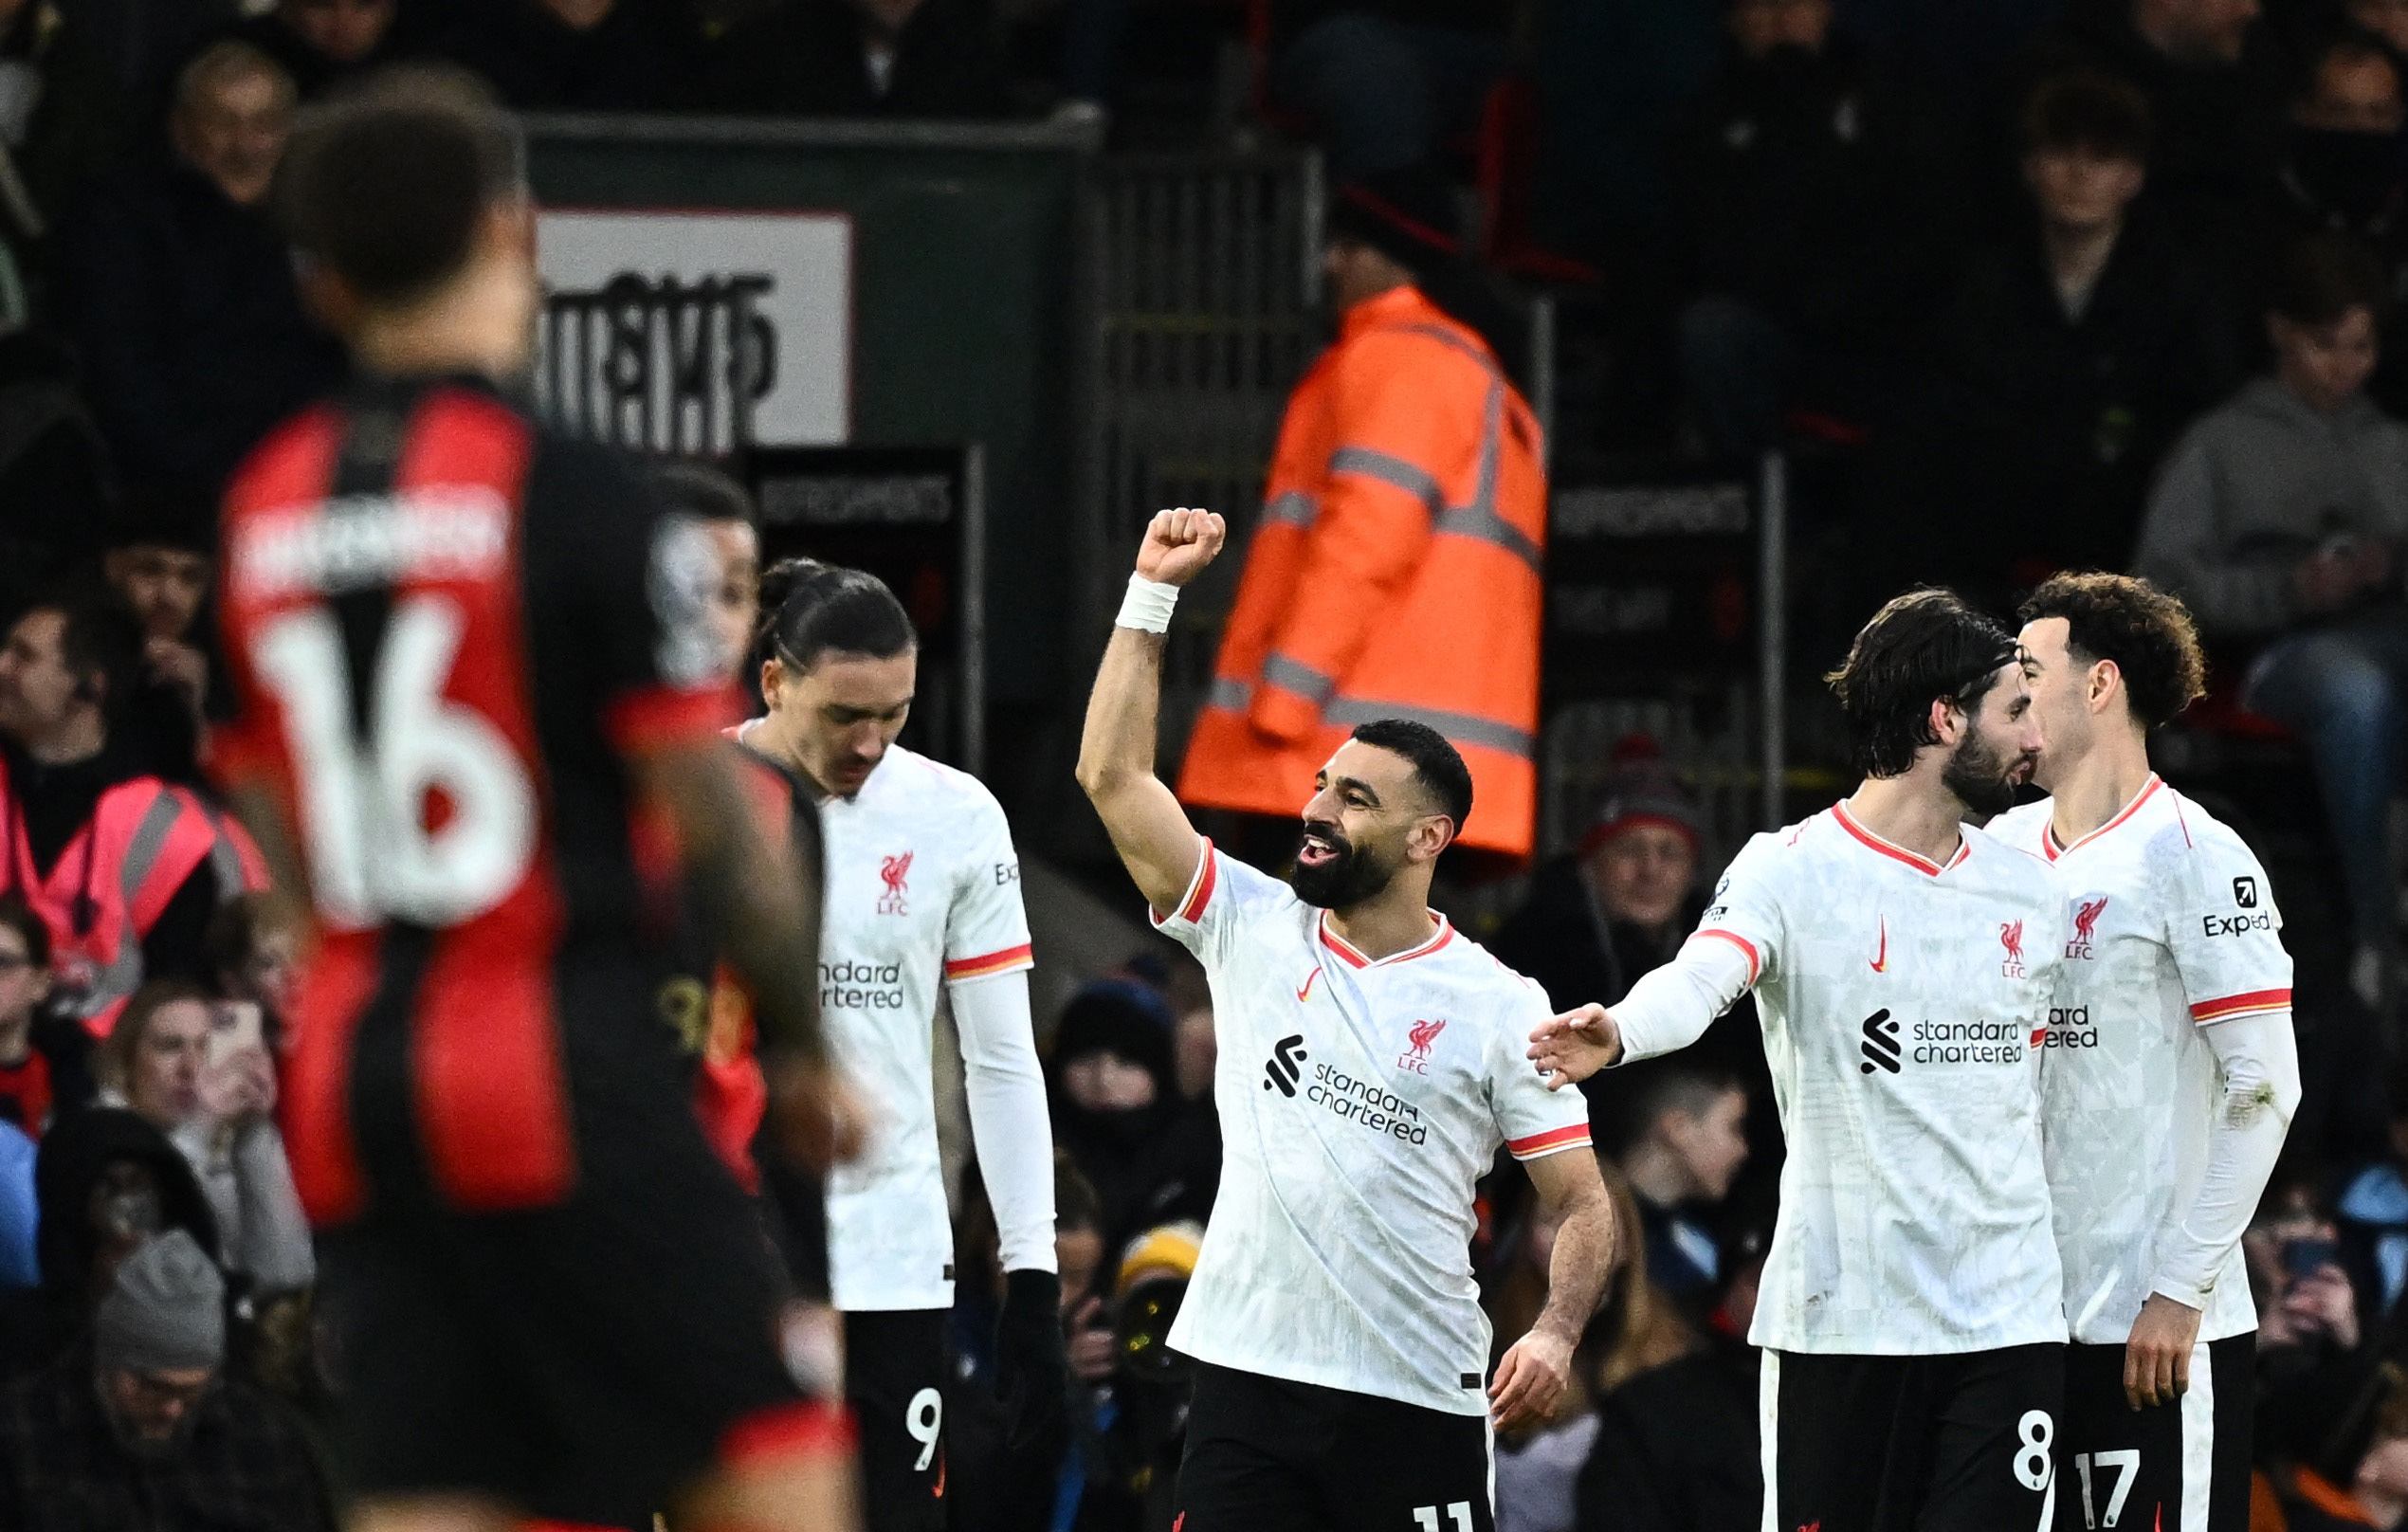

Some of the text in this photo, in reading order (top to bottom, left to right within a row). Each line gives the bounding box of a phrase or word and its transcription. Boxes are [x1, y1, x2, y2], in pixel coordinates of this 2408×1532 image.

[253, 600, 539, 928] 16
[2065, 945, 2094, 960] LFC
[2001, 965, 2027, 979] LFC
[2049, 1004, 2089, 1025] ard
[1913, 1019, 2018, 1041] standard
[1913, 1042, 2022, 1064] chartered
[1396, 1056, 1429, 1076] LFC
[1307, 1085, 1427, 1145] chartered
[905, 1388, 942, 1470] 9
[2013, 1410, 2053, 1491] 8
[2074, 1449, 2141, 1530] 17
